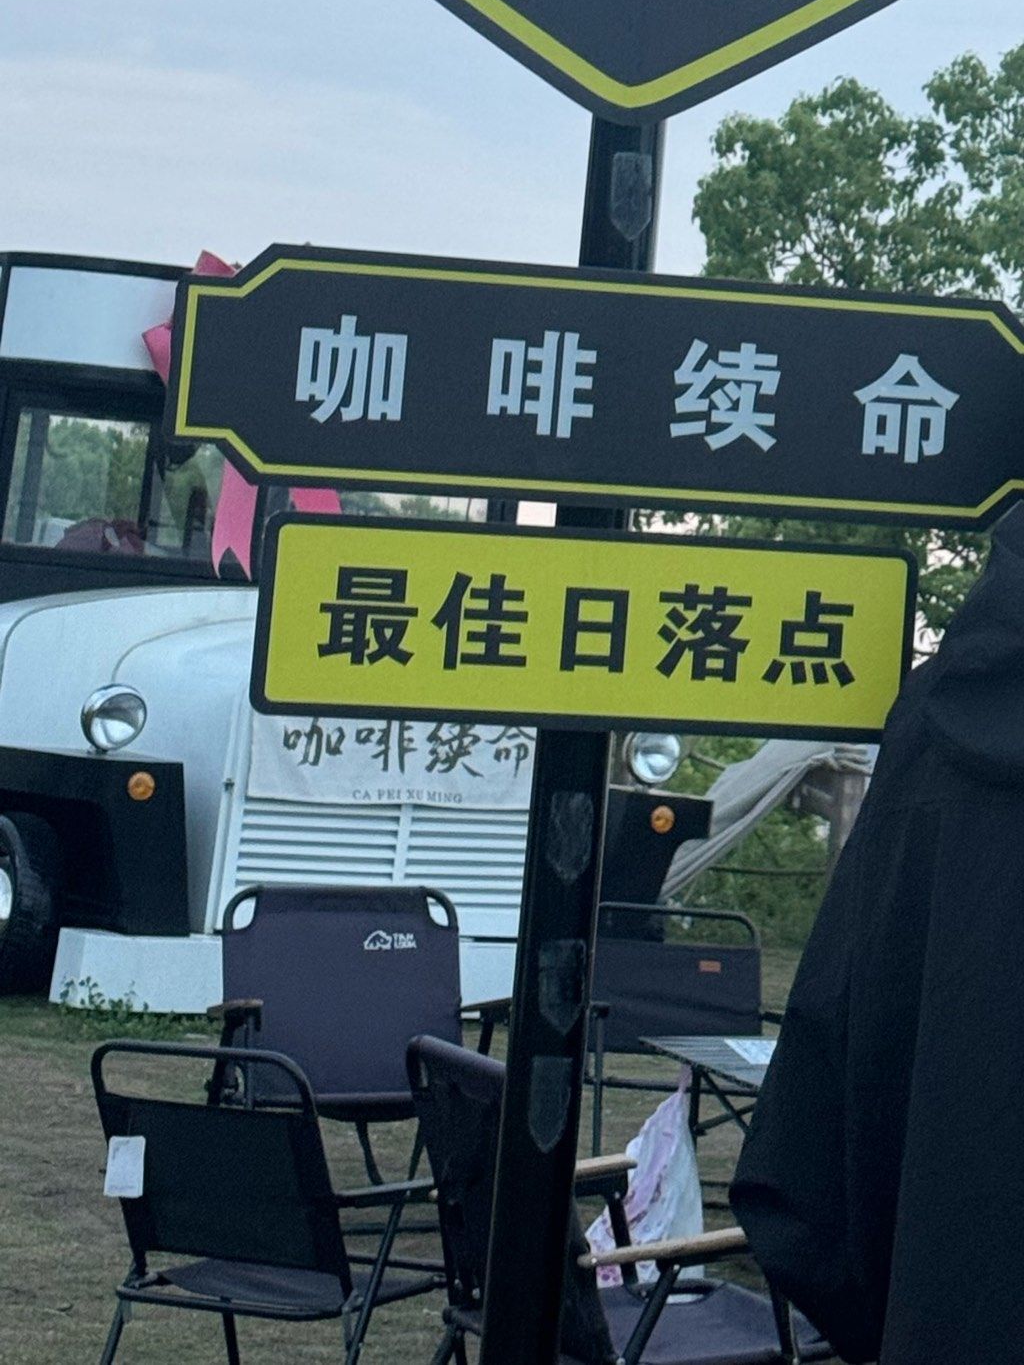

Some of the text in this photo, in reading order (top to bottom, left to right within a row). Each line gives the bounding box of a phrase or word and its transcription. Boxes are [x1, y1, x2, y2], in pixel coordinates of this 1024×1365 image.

[294, 314, 961, 464] 咖啡续命
[316, 565, 856, 689] 最佳日落点
